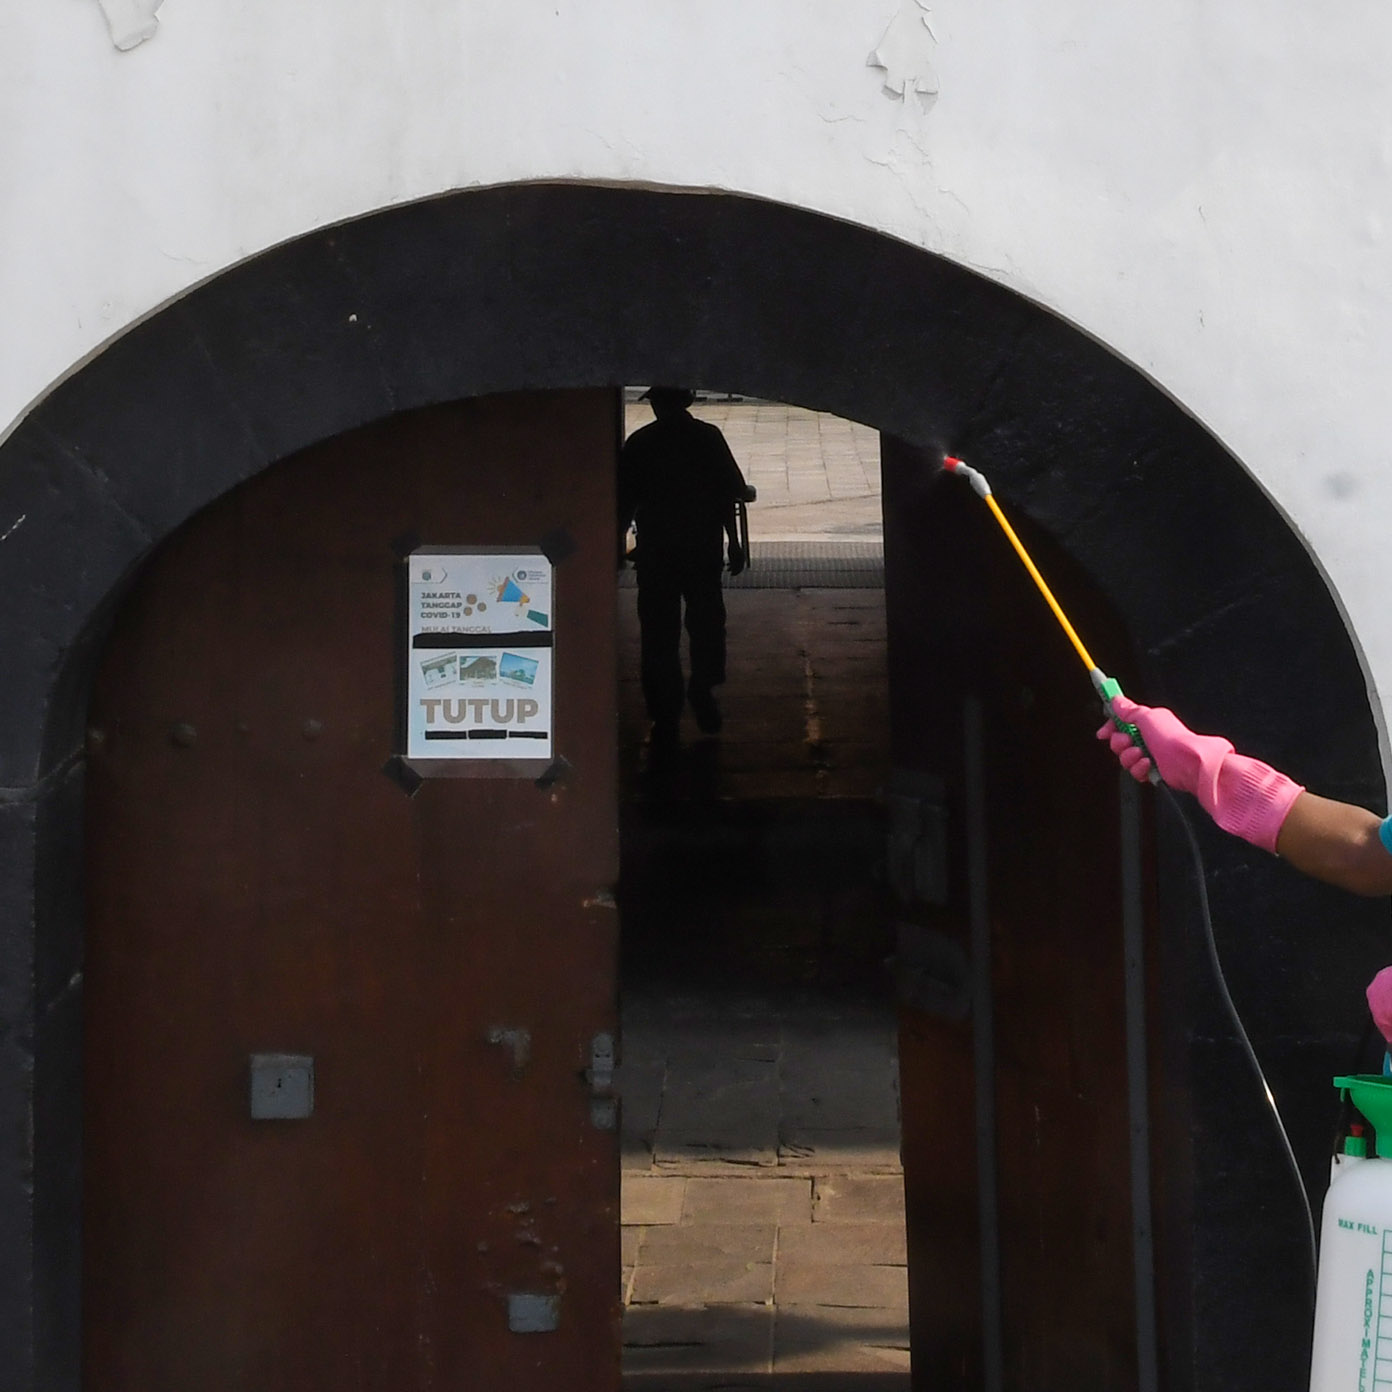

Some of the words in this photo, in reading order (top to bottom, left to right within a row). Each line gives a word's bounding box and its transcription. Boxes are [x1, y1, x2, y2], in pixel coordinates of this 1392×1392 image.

[420, 698, 539, 724] TUTUP
[1338, 1218, 1355, 1230] MAX
[1357, 1223, 1378, 1235] FILL
